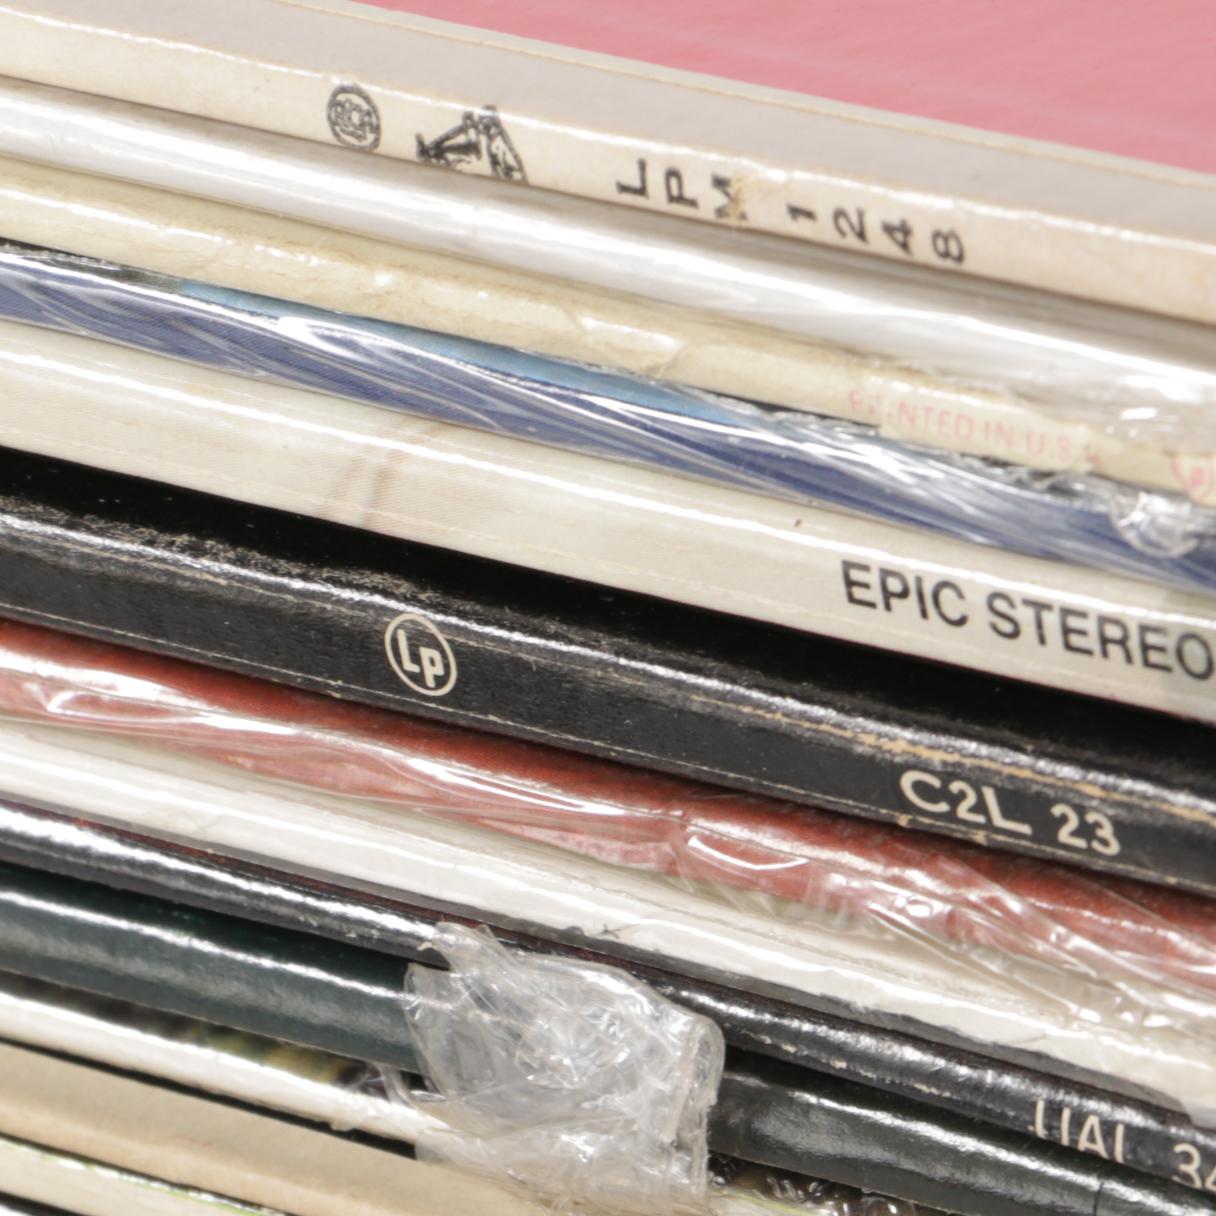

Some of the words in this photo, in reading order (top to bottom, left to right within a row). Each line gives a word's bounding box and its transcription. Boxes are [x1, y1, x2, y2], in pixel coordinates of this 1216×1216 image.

[787, 203, 965, 265] 1248
[841, 560, 969, 628] EPIC
[986, 591, 1216, 681] STEREO
[901, 769, 1033, 836] C2L
[1050, 802, 1121, 856] 23
